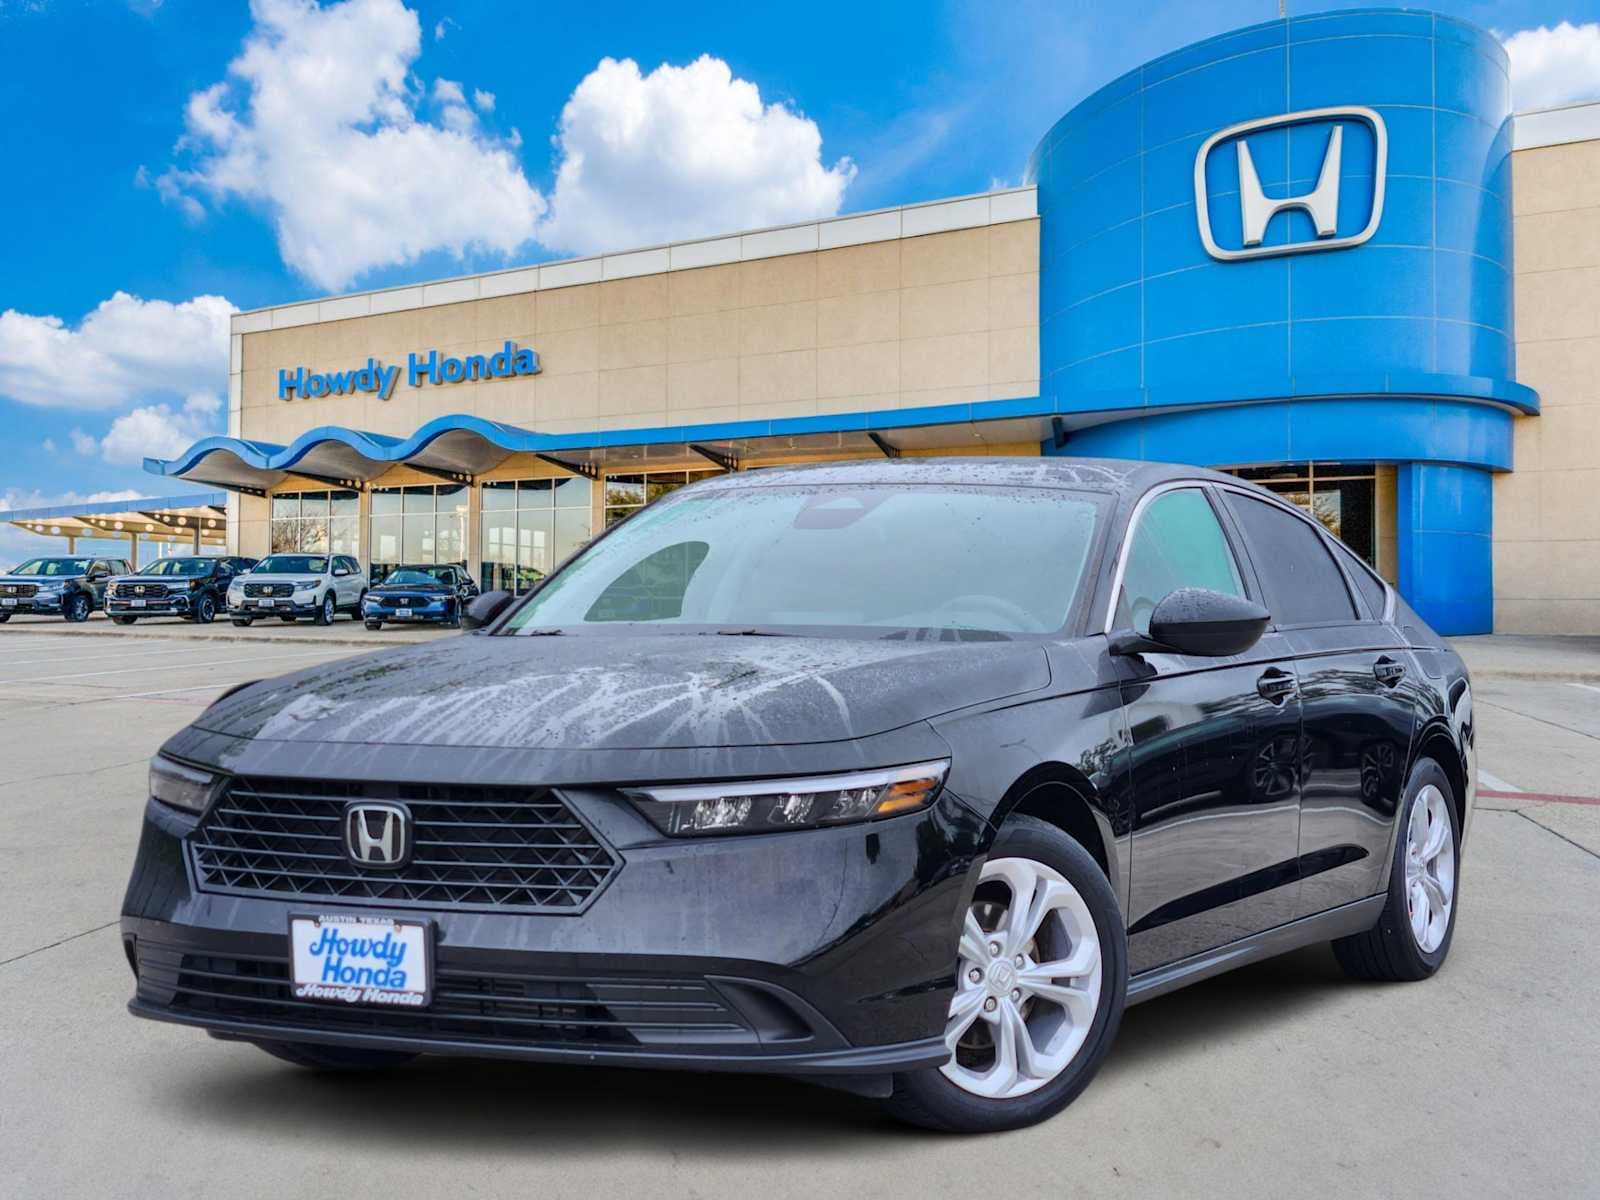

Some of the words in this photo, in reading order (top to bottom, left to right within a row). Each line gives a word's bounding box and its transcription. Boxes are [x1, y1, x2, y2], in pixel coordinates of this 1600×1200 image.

[279, 358, 400, 400] Howdy
[408, 341, 541, 387] Honda
[310, 927, 407, 967] Howdy
[321, 956, 407, 989] Honda
[296, 983, 362, 1003] Howdy
[362, 988, 424, 1005] Honda
